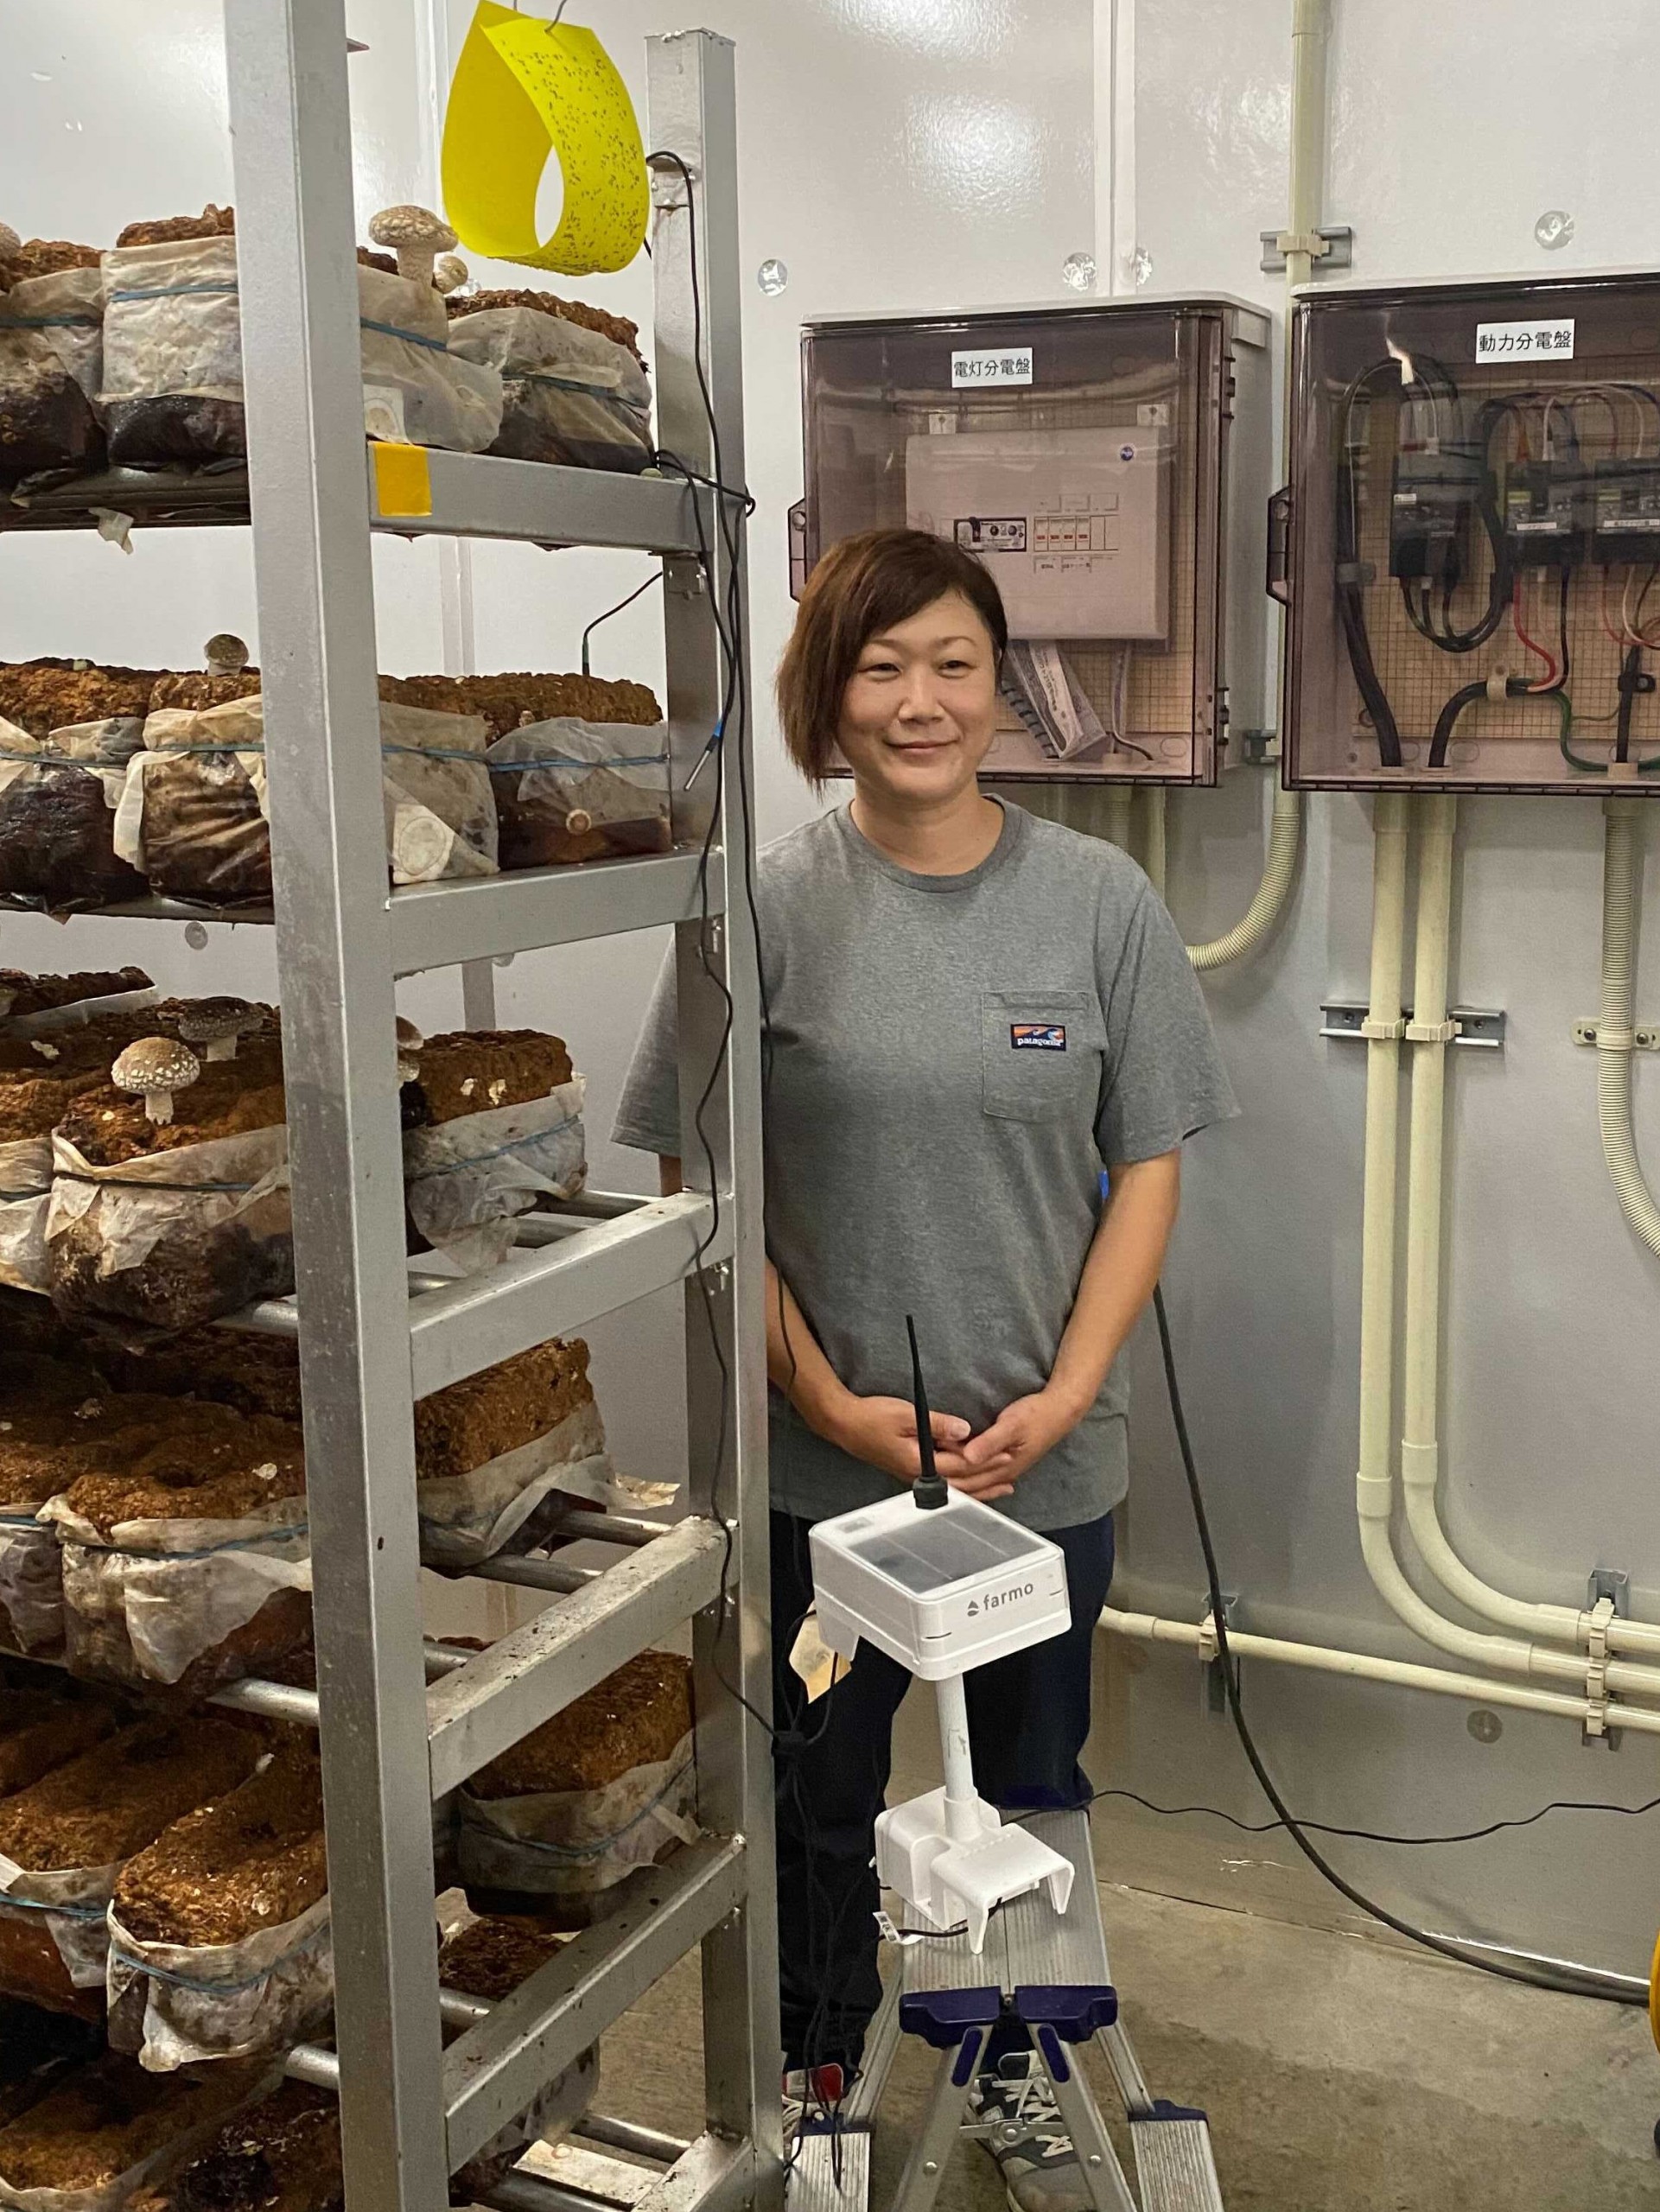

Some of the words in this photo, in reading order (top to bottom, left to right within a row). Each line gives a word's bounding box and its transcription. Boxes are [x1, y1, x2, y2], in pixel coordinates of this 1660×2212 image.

[1479, 330, 1572, 353] 動力分電盤
[954, 358, 1030, 378] 電灯分電盤
[983, 1583, 1034, 1611] farmo
